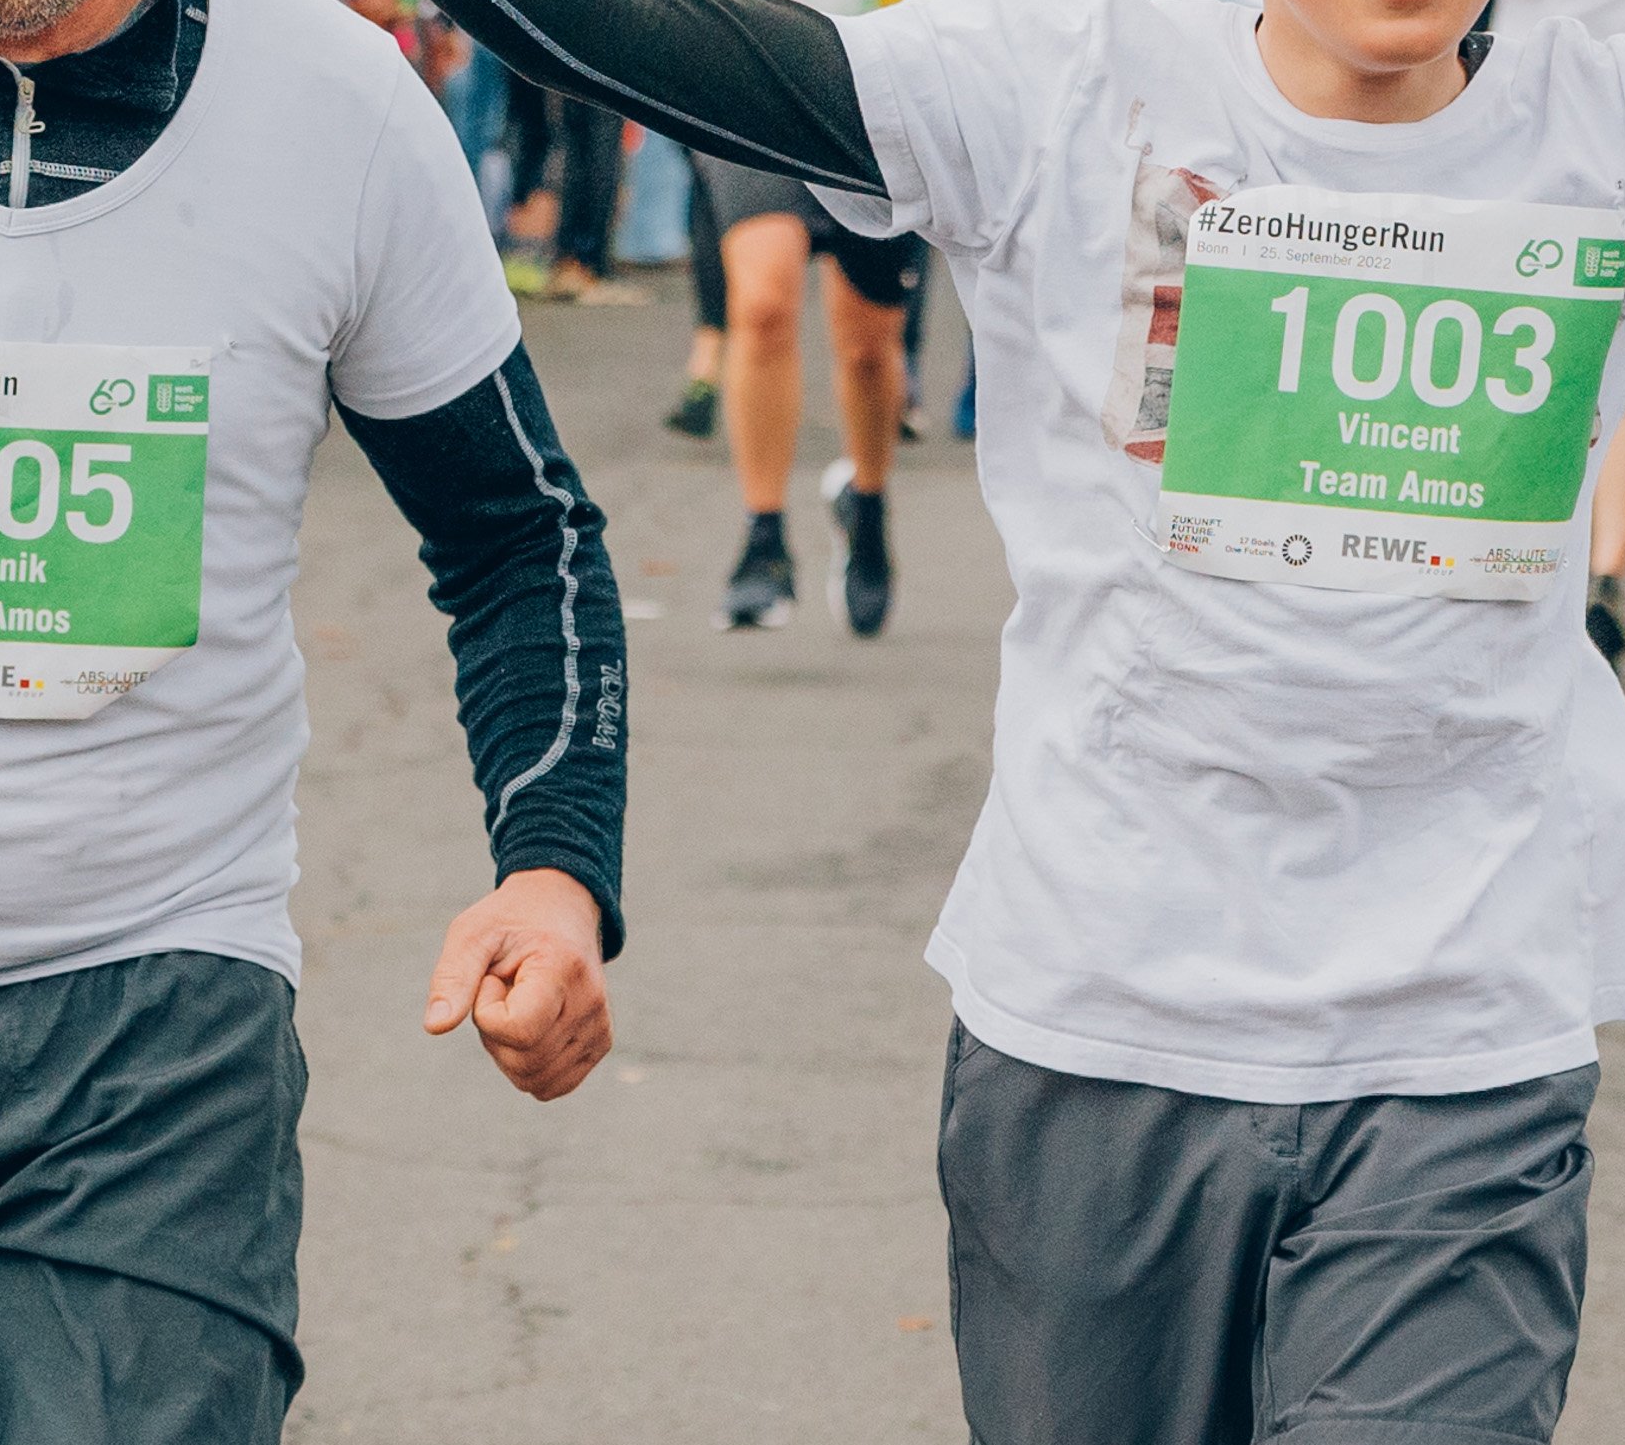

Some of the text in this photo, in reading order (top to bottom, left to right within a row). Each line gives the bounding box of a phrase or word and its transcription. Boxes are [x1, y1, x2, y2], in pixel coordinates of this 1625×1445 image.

[1198, 206, 1445, 253] #ZeroHungerRun
[1197, 241, 1228, 255] Bonn
[1260, 246, 1281, 260] 25.
[1286, 249, 1351, 267] September
[1357, 256, 1391, 270] 2022
[1271, 286, 1555, 413] 1003
[1338, 412, 1461, 454] Vincent
[1299, 460, 1484, 508] Team Amos
[1341, 534, 1427, 565] REWE
[1486, 548, 1547, 562] ABSOLUTE
